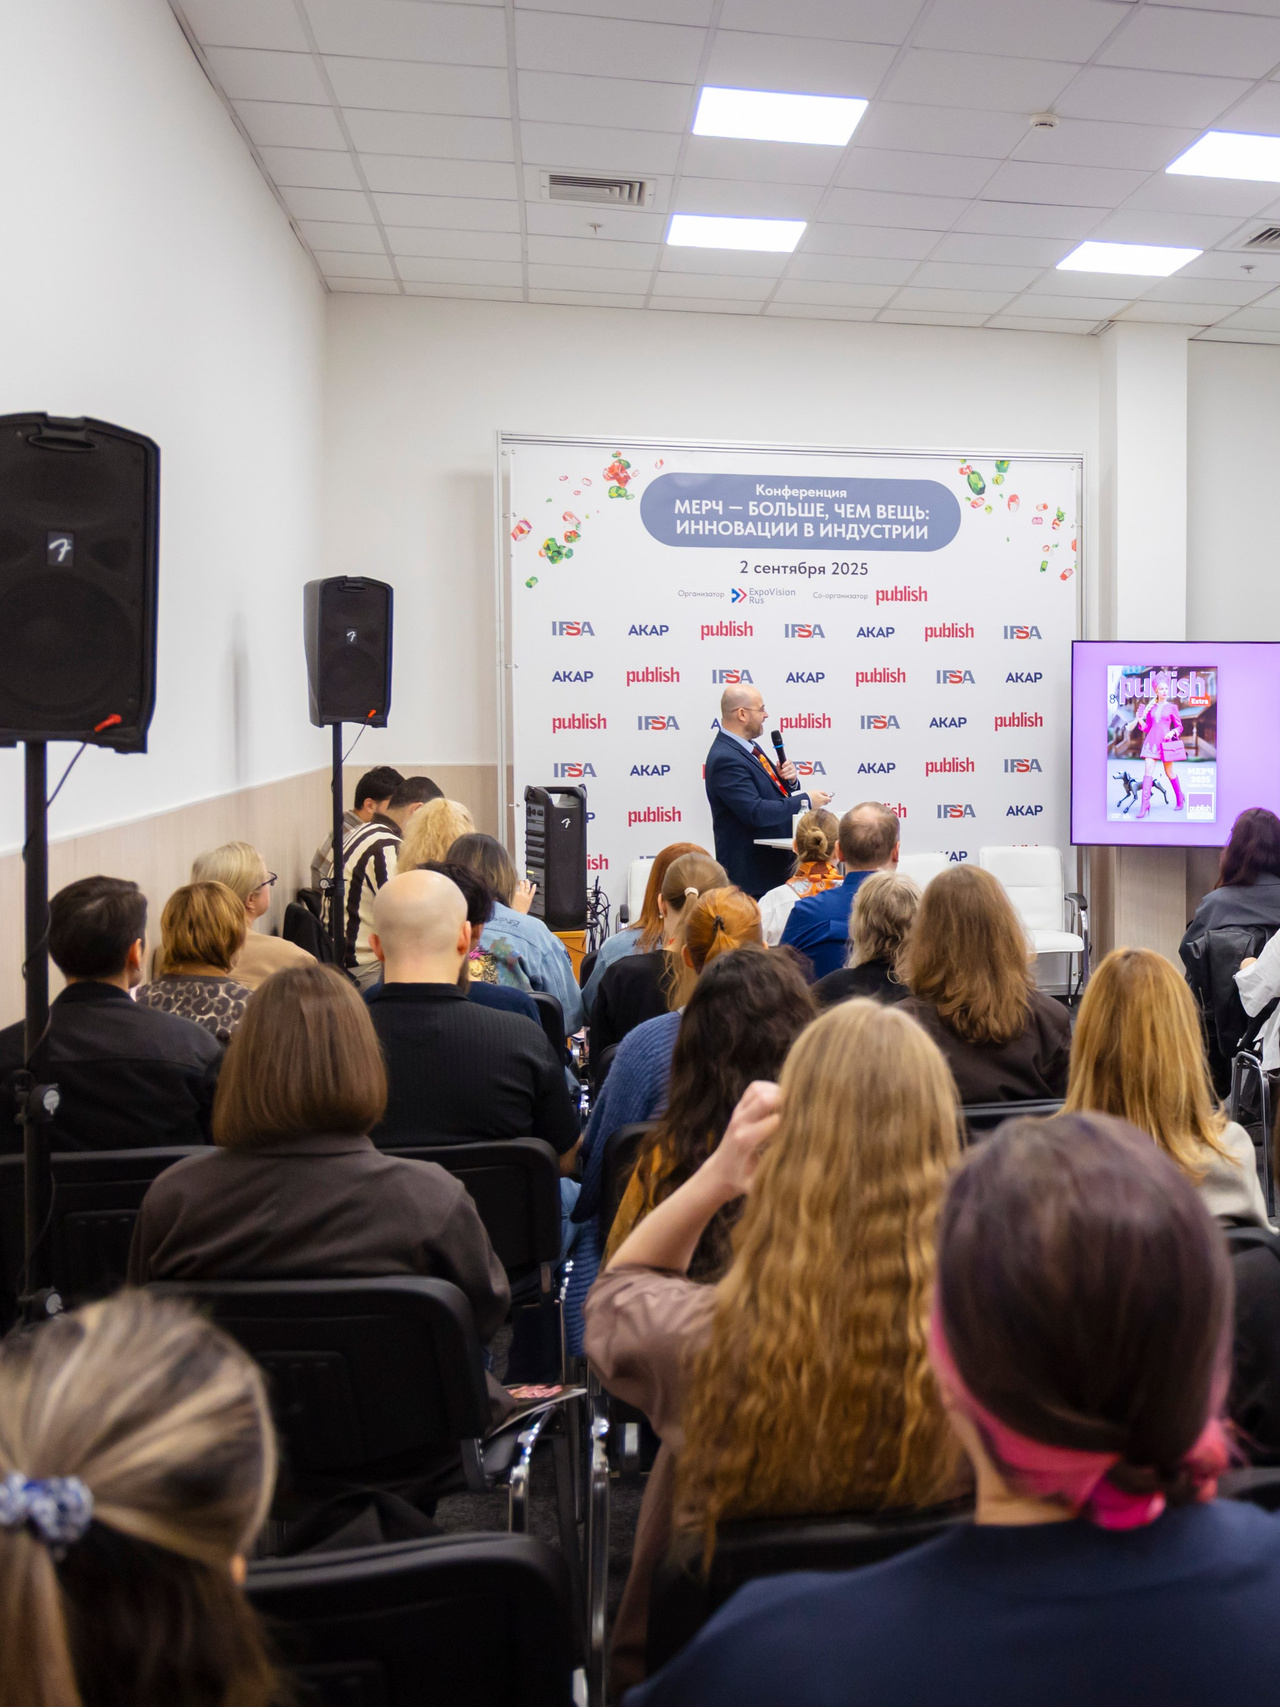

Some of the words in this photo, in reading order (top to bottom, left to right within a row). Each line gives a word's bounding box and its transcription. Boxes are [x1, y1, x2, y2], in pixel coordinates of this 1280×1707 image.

[756, 484, 847, 500] Конференция
[675, 499, 723, 515] МЕРЧ
[749, 501, 829, 520] БОЛЬШЕ,
[834, 503, 871, 519] ЧЕМ
[876, 505, 930, 522] ВЕЩЬ:
[676, 520, 798, 539] ИННОВАЦИИ
[804, 523, 814, 537] В
[820, 523, 928, 541] ИНДУСТРИИ
[740, 560, 749, 574] 2
[754, 561, 826, 579] сентября
[831, 562, 868, 576] 2025
[678, 589, 725, 599] Организатор
[749, 587, 796, 598] ExpoVision
[749, 596, 765, 604] Rus
[813, 591, 868, 601] Со-организатор
[876, 586, 928, 606] publish
[701, 620, 753, 640] publish
[925, 623, 974, 642] publish
[627, 667, 680, 687] publish
[856, 667, 906, 687] publish
[552, 712, 607, 734] publish
[780, 713, 831, 732] publish
[995, 711, 1043, 731] publish
[926, 757, 975, 777] publish
[628, 806, 682, 827] publish
